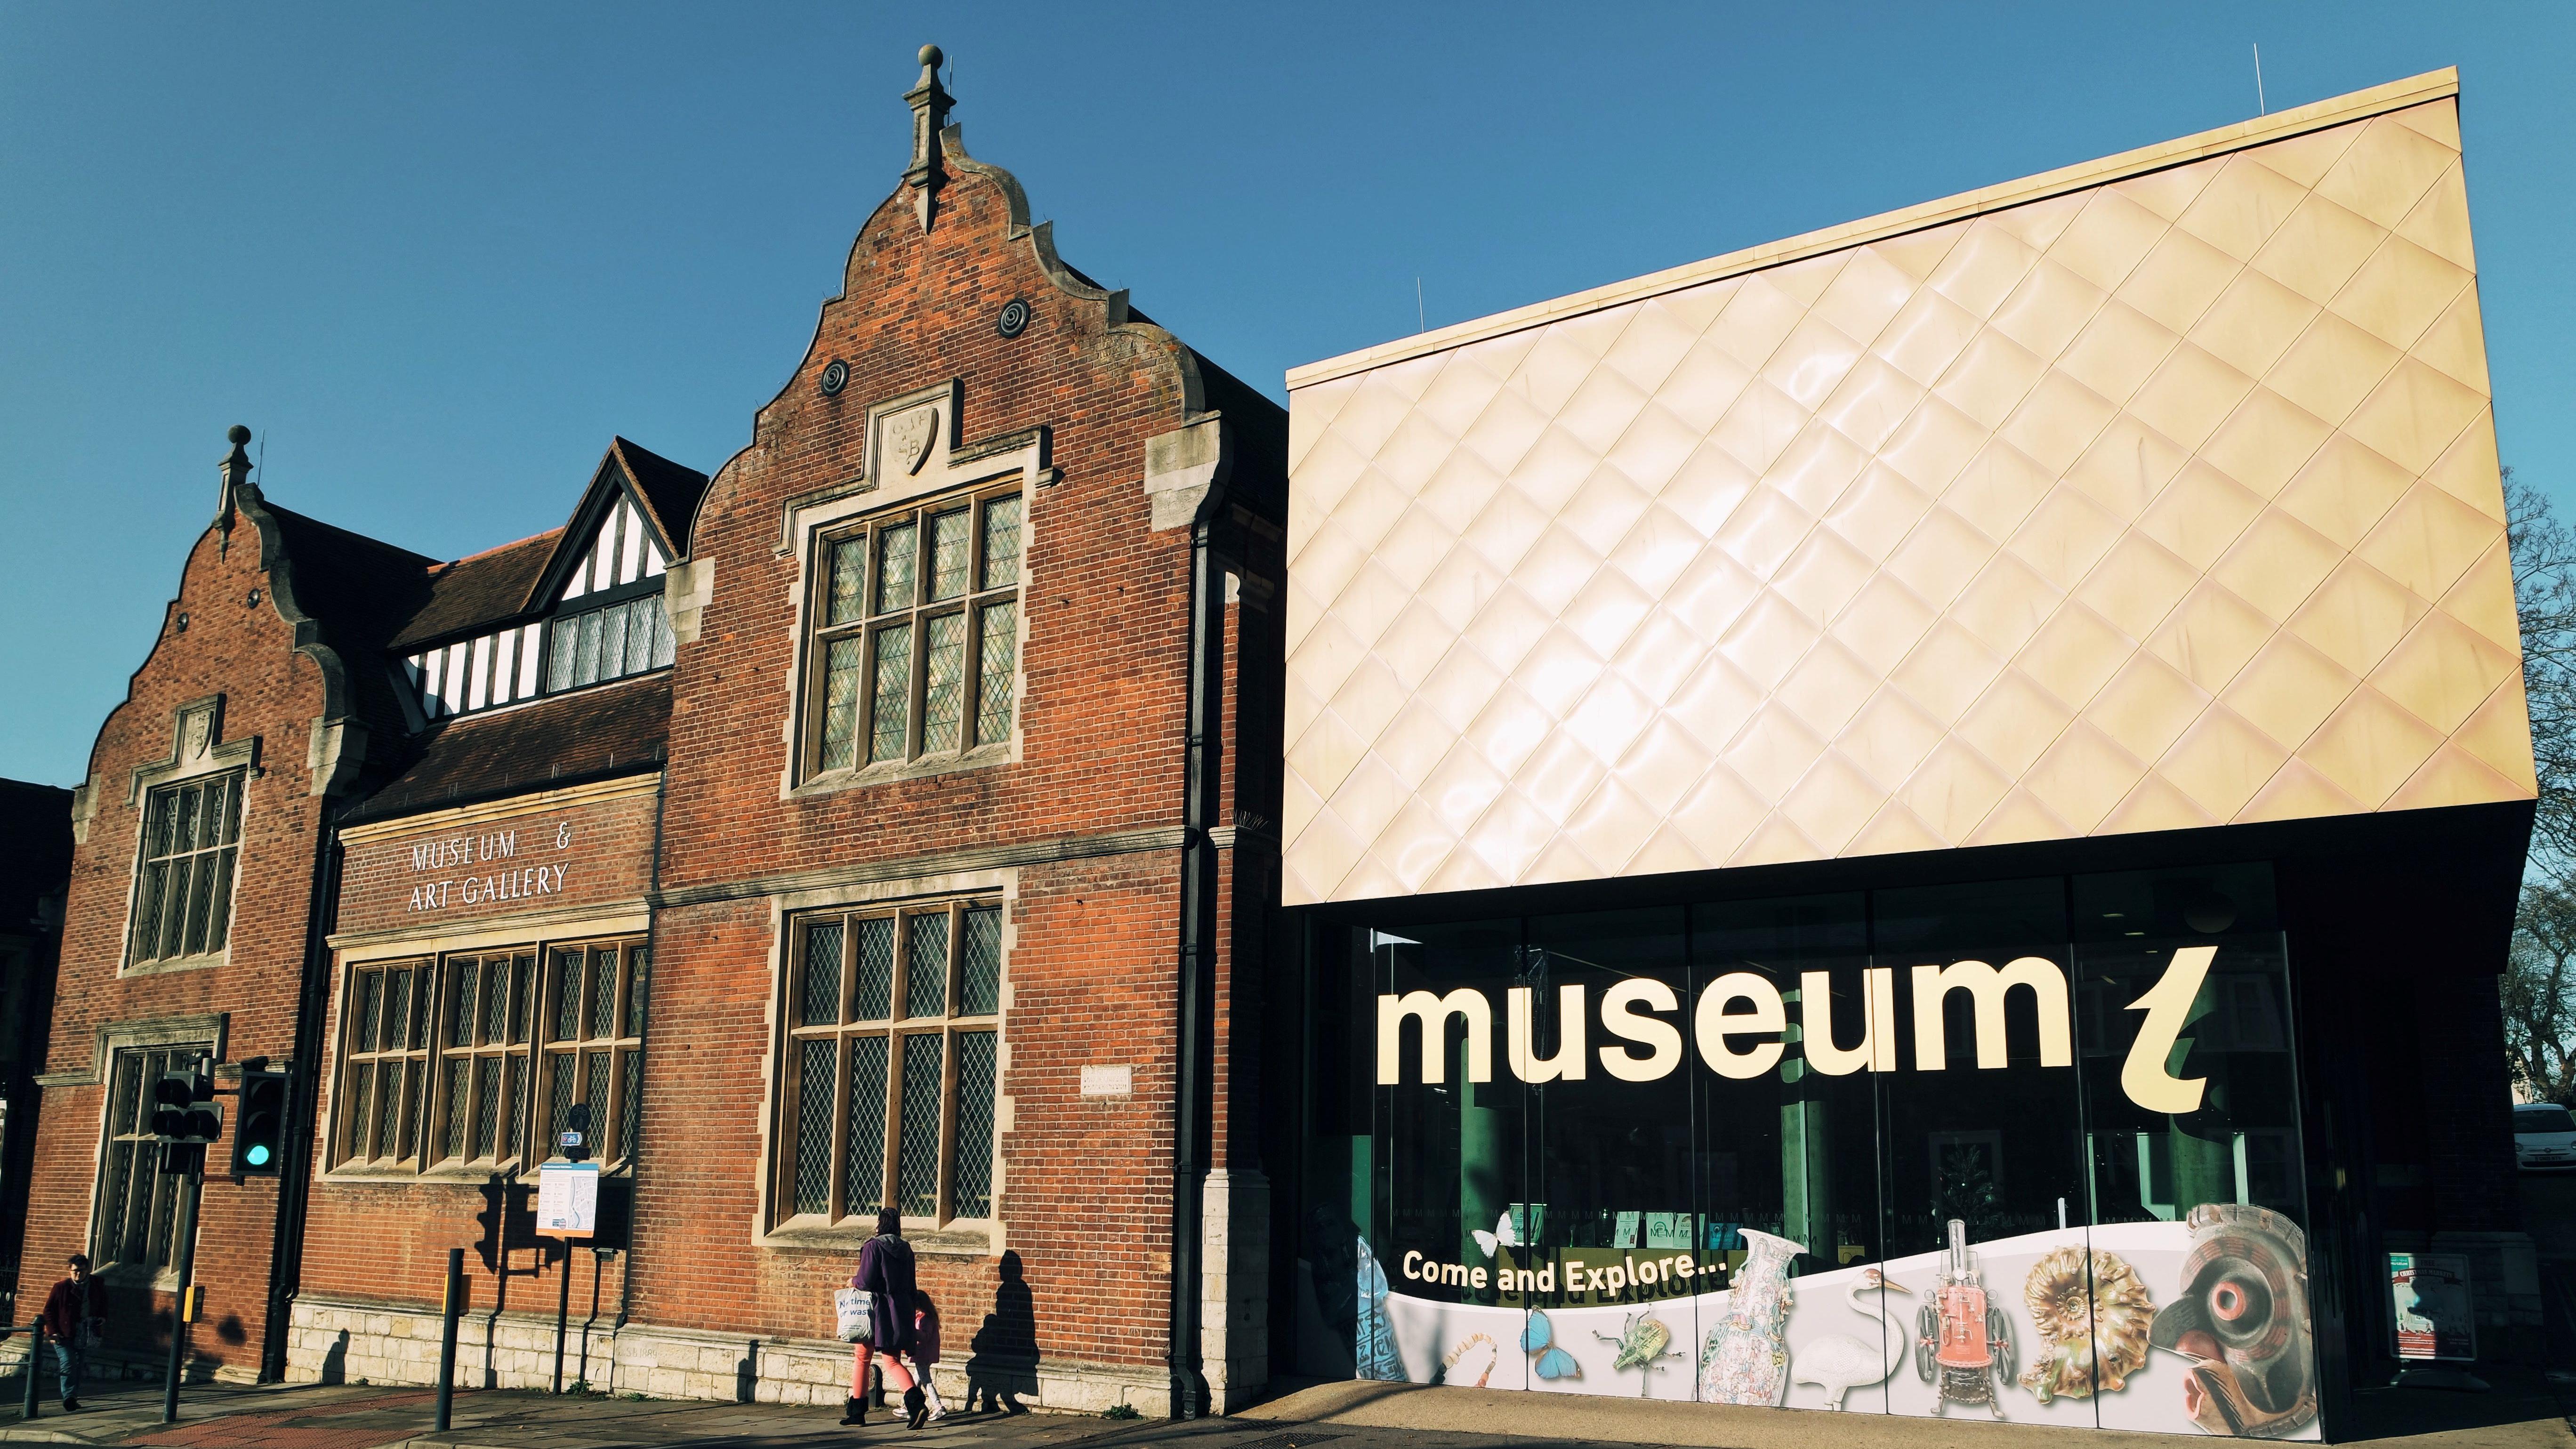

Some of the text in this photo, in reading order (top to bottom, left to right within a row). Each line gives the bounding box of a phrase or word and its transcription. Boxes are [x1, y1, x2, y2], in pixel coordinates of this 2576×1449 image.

[411, 821, 571, 872] MUSEUM &
[408, 862, 570, 912] ART GALLERY
[1377, 957, 2072, 1085] museum
[1403, 1250, 1727, 1297] Come and Explore...
[851, 1297, 870, 1305] time
